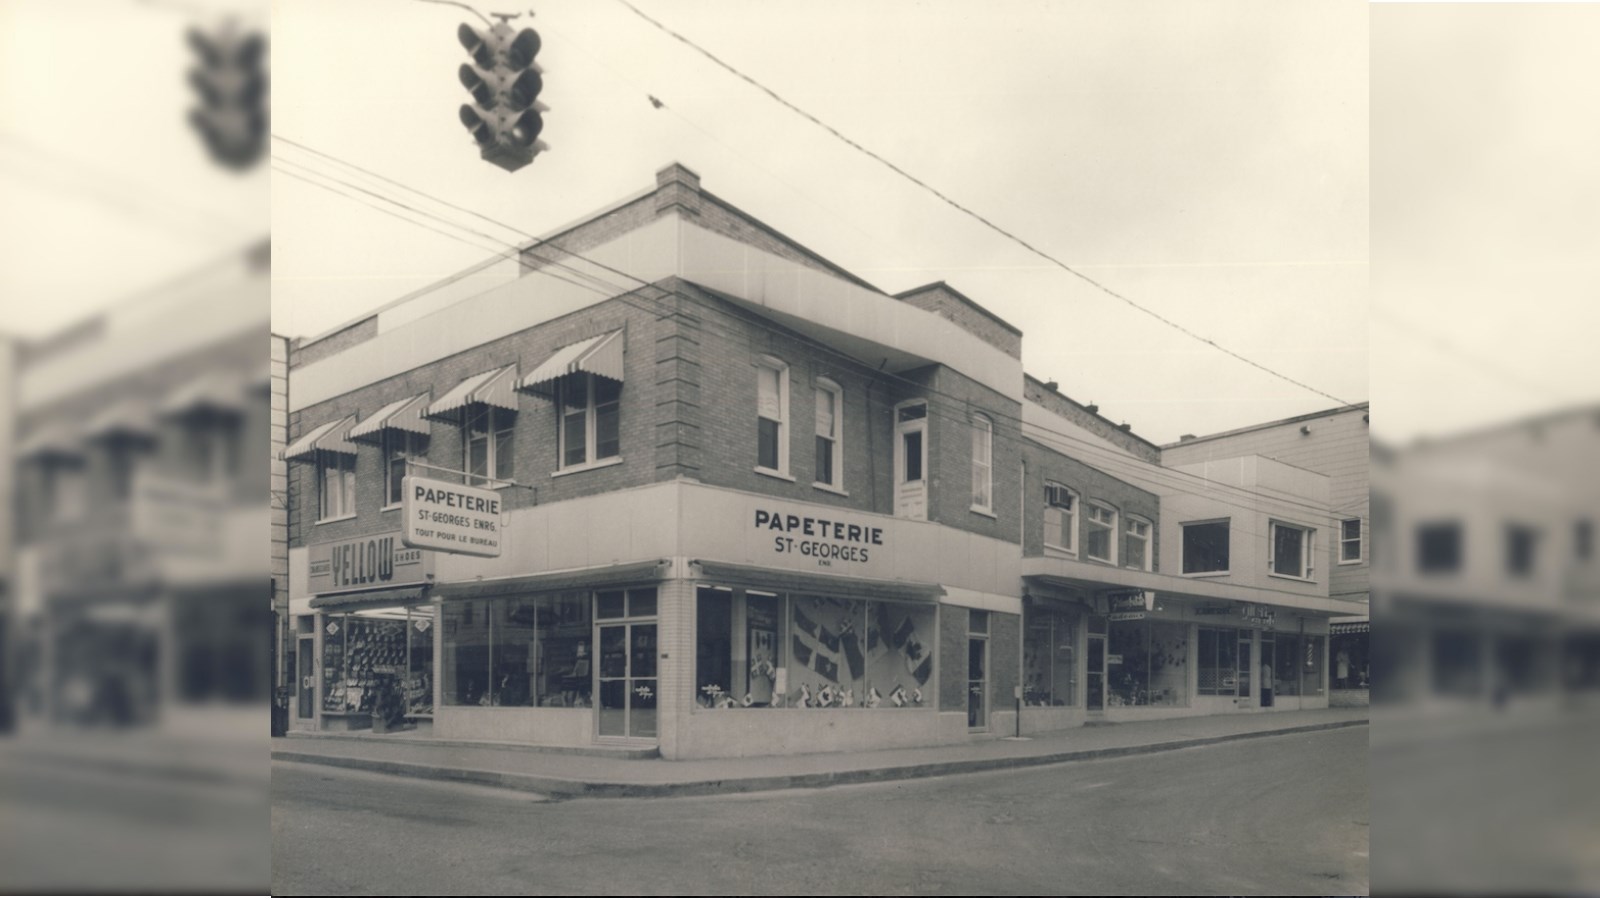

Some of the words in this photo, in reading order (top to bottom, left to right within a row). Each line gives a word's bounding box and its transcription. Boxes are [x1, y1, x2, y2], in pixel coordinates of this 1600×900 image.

[415, 486, 499, 515] PAPETERIE
[418, 509, 470, 528] ST-GEORGES
[473, 519, 497, 532] ENRG.
[755, 509, 883, 545] PAPETERIE
[415, 528, 434, 538] TOUT
[437, 531, 456, 541] POUR
[458, 535, 468, 543] LE
[470, 537, 498, 547] BUREAU
[332, 537, 394, 587] YELLOW
[394, 550, 420, 562] SHOES
